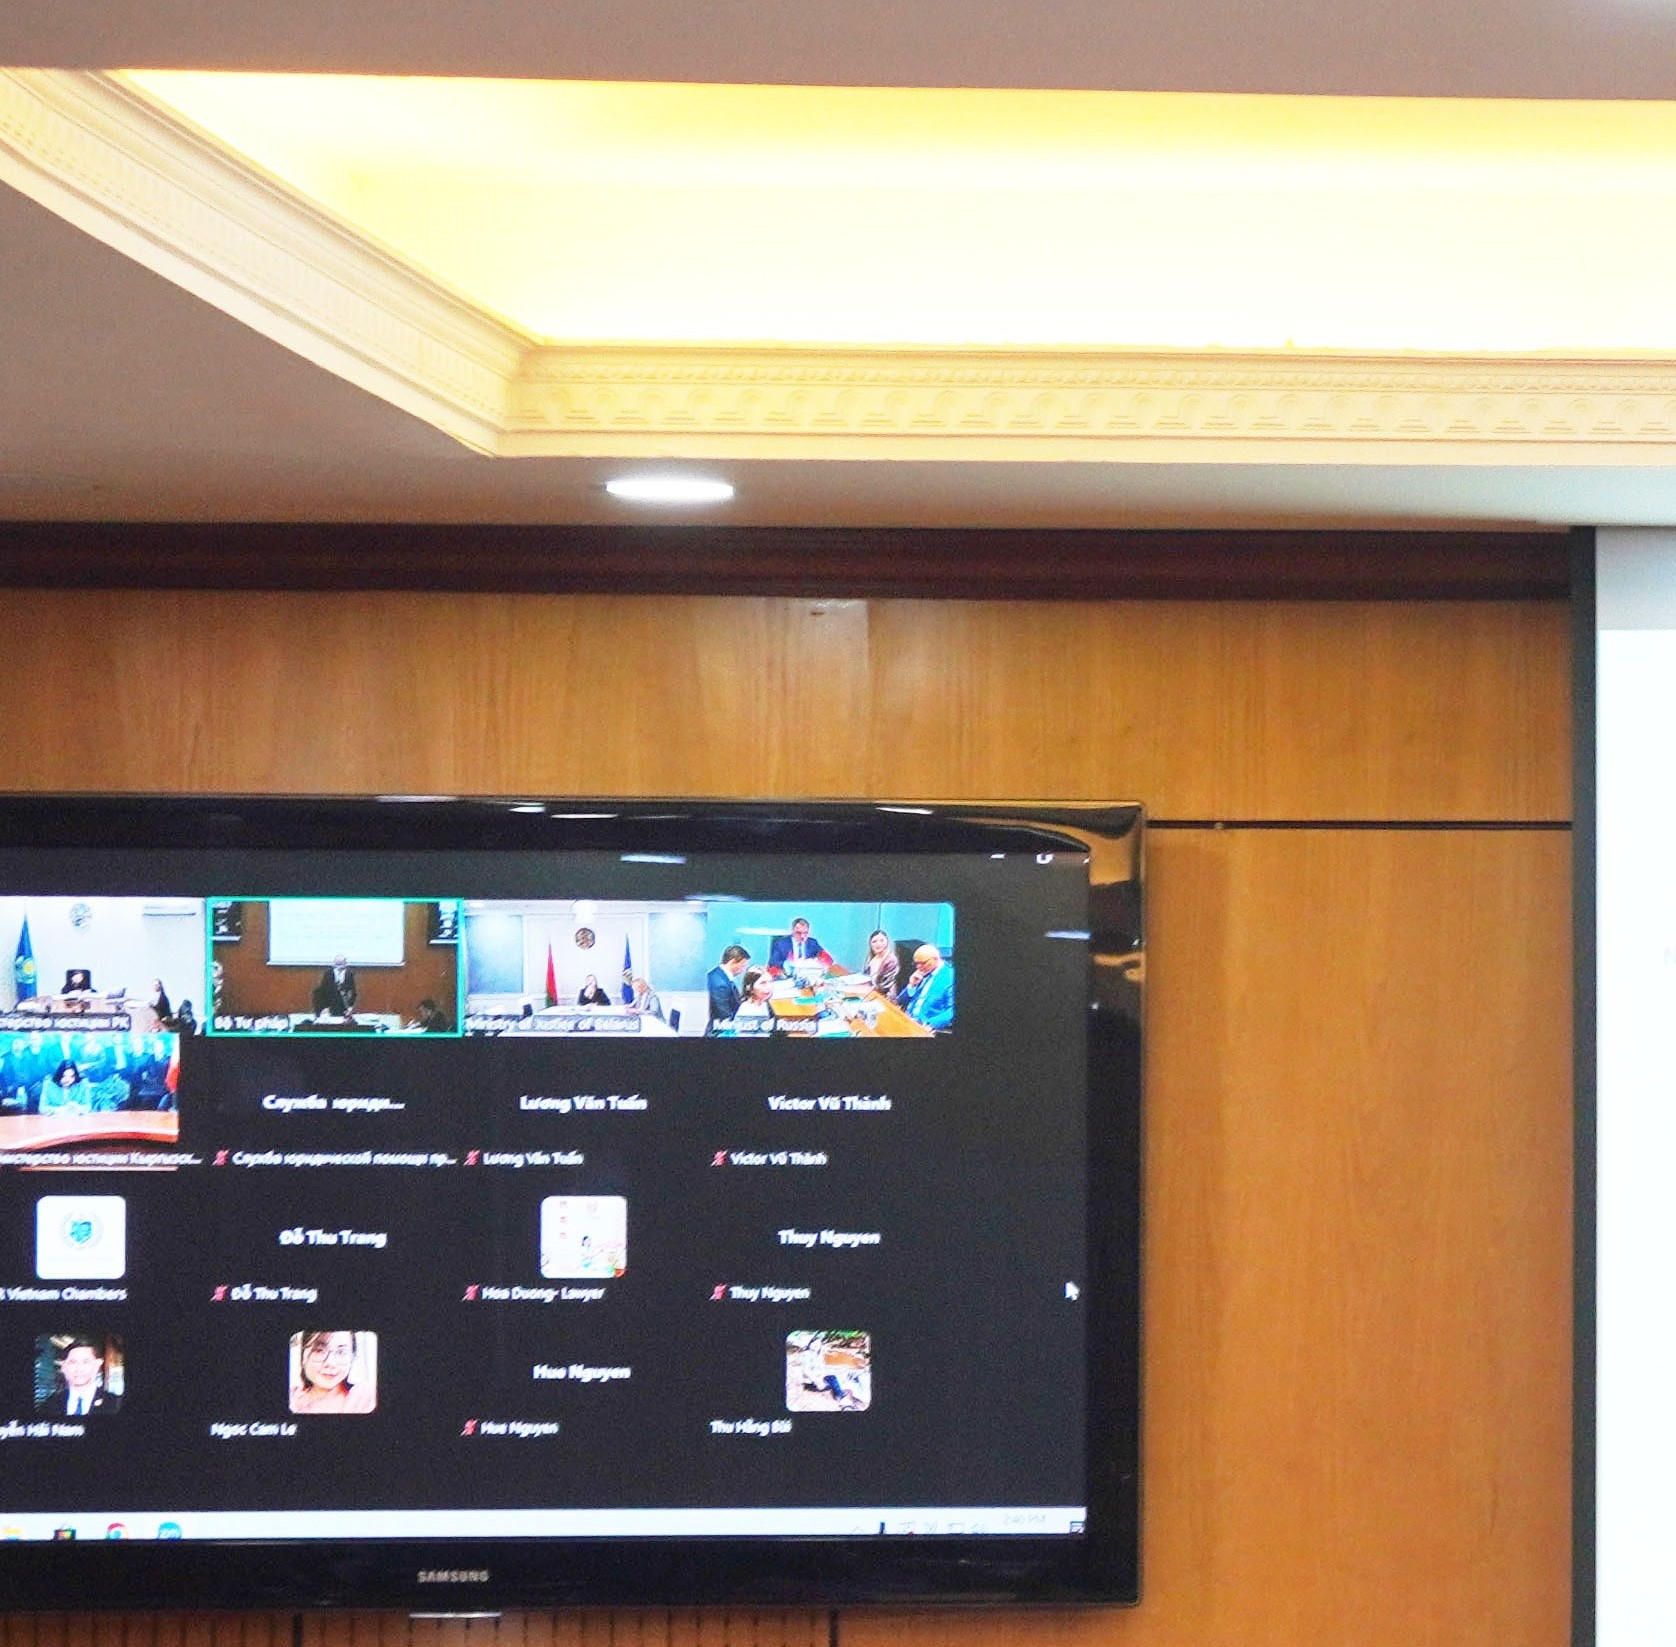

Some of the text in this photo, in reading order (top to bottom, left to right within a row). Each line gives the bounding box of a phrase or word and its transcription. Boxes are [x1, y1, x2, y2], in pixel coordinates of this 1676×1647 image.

[262, 1094, 327, 1113] Служба
[768, 1095, 817, 1111] Victor
[730, 1150, 767, 1166] Victor
[306, 1229, 337, 1246] Thu
[338, 1230, 388, 1249] Trang
[778, 1228, 881, 1247] Thuy Nguyen
[64, 1285, 127, 1302] Chambers
[254, 1285, 279, 1301] Thu
[729, 1284, 758, 1302] Thuy
[568, 1363, 631, 1383] Nguyen
[416, 1569, 491, 1584] SAMSUNG
